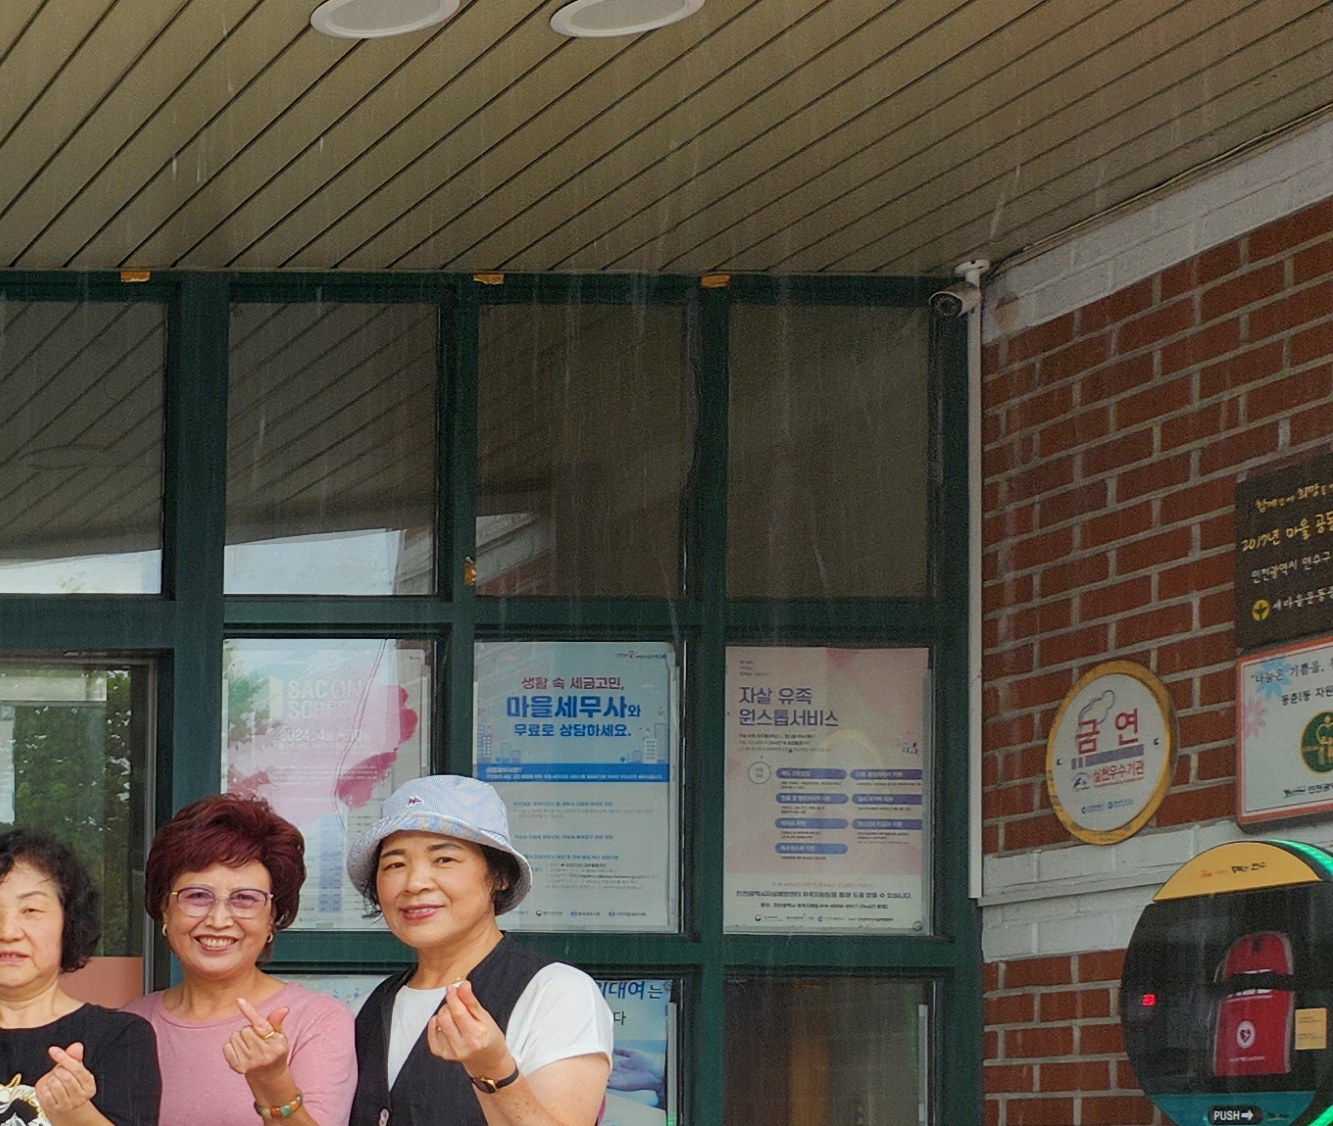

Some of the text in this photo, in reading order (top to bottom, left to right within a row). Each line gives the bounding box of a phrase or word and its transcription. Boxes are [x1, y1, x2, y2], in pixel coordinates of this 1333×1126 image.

[1286, 518, 1311, 541] 마을
[521, 676, 624, 691] 생활 속 세금고민,
[738, 686, 813, 705] 자살 유족
[506, 695, 641, 719] 마을세무사와
[738, 708, 839, 727] 원스톱서비스
[513, 723, 631, 738] 무료로 상담하세요.
[1213, 1108, 1241, 1122] PUSH
